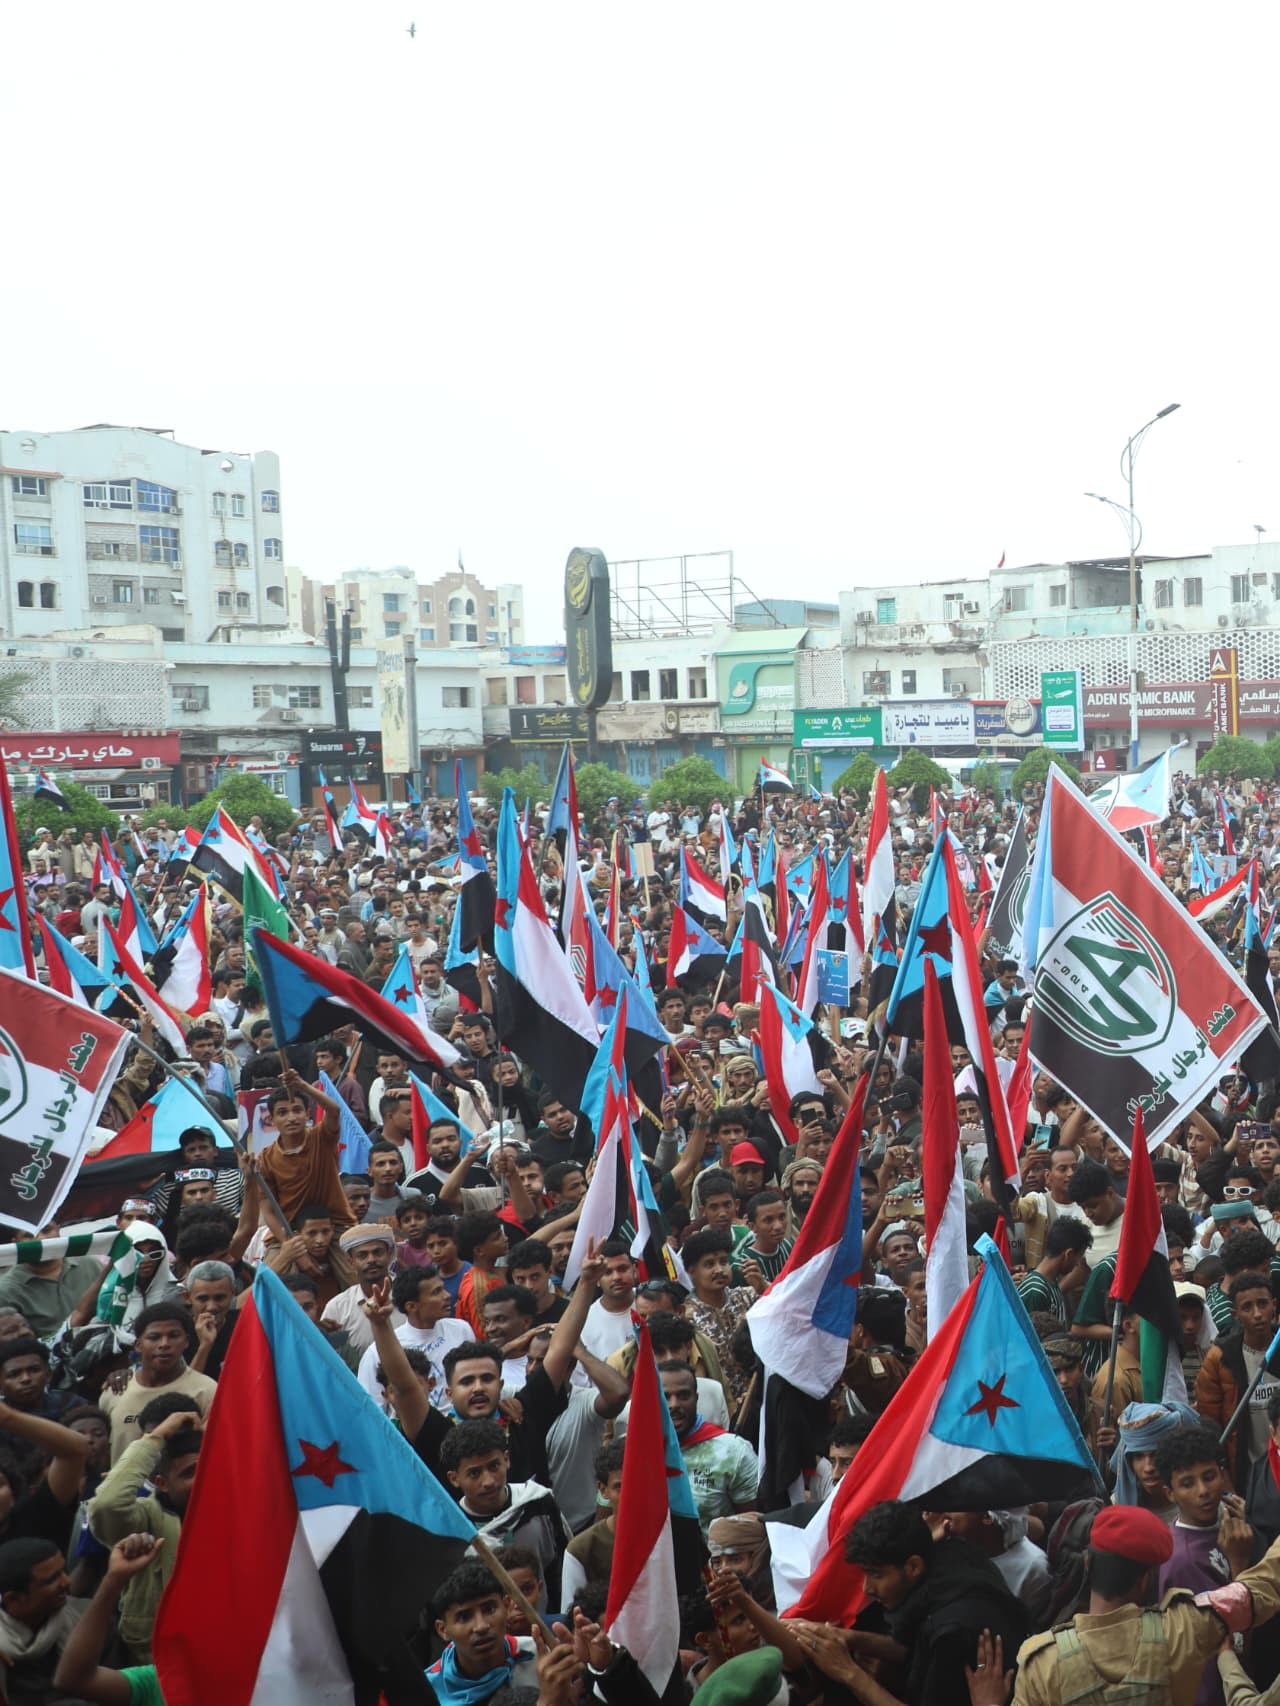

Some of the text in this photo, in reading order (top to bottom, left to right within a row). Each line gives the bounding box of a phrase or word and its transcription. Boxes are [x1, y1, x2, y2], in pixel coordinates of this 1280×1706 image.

[1087, 690, 1196, 706] ADEN ISAMIC BANK
[1144, 707, 1196, 717] MICROFINANCE
[895, 714, 970, 731] باعبيد للتجارة
[28, 745, 90, 763] بارك
[92, 744, 134, 762] هاي
[1171, 1025, 1211, 1080] الرجال
[10, 1031, 98, 1200] عهد الرجال للرجال
